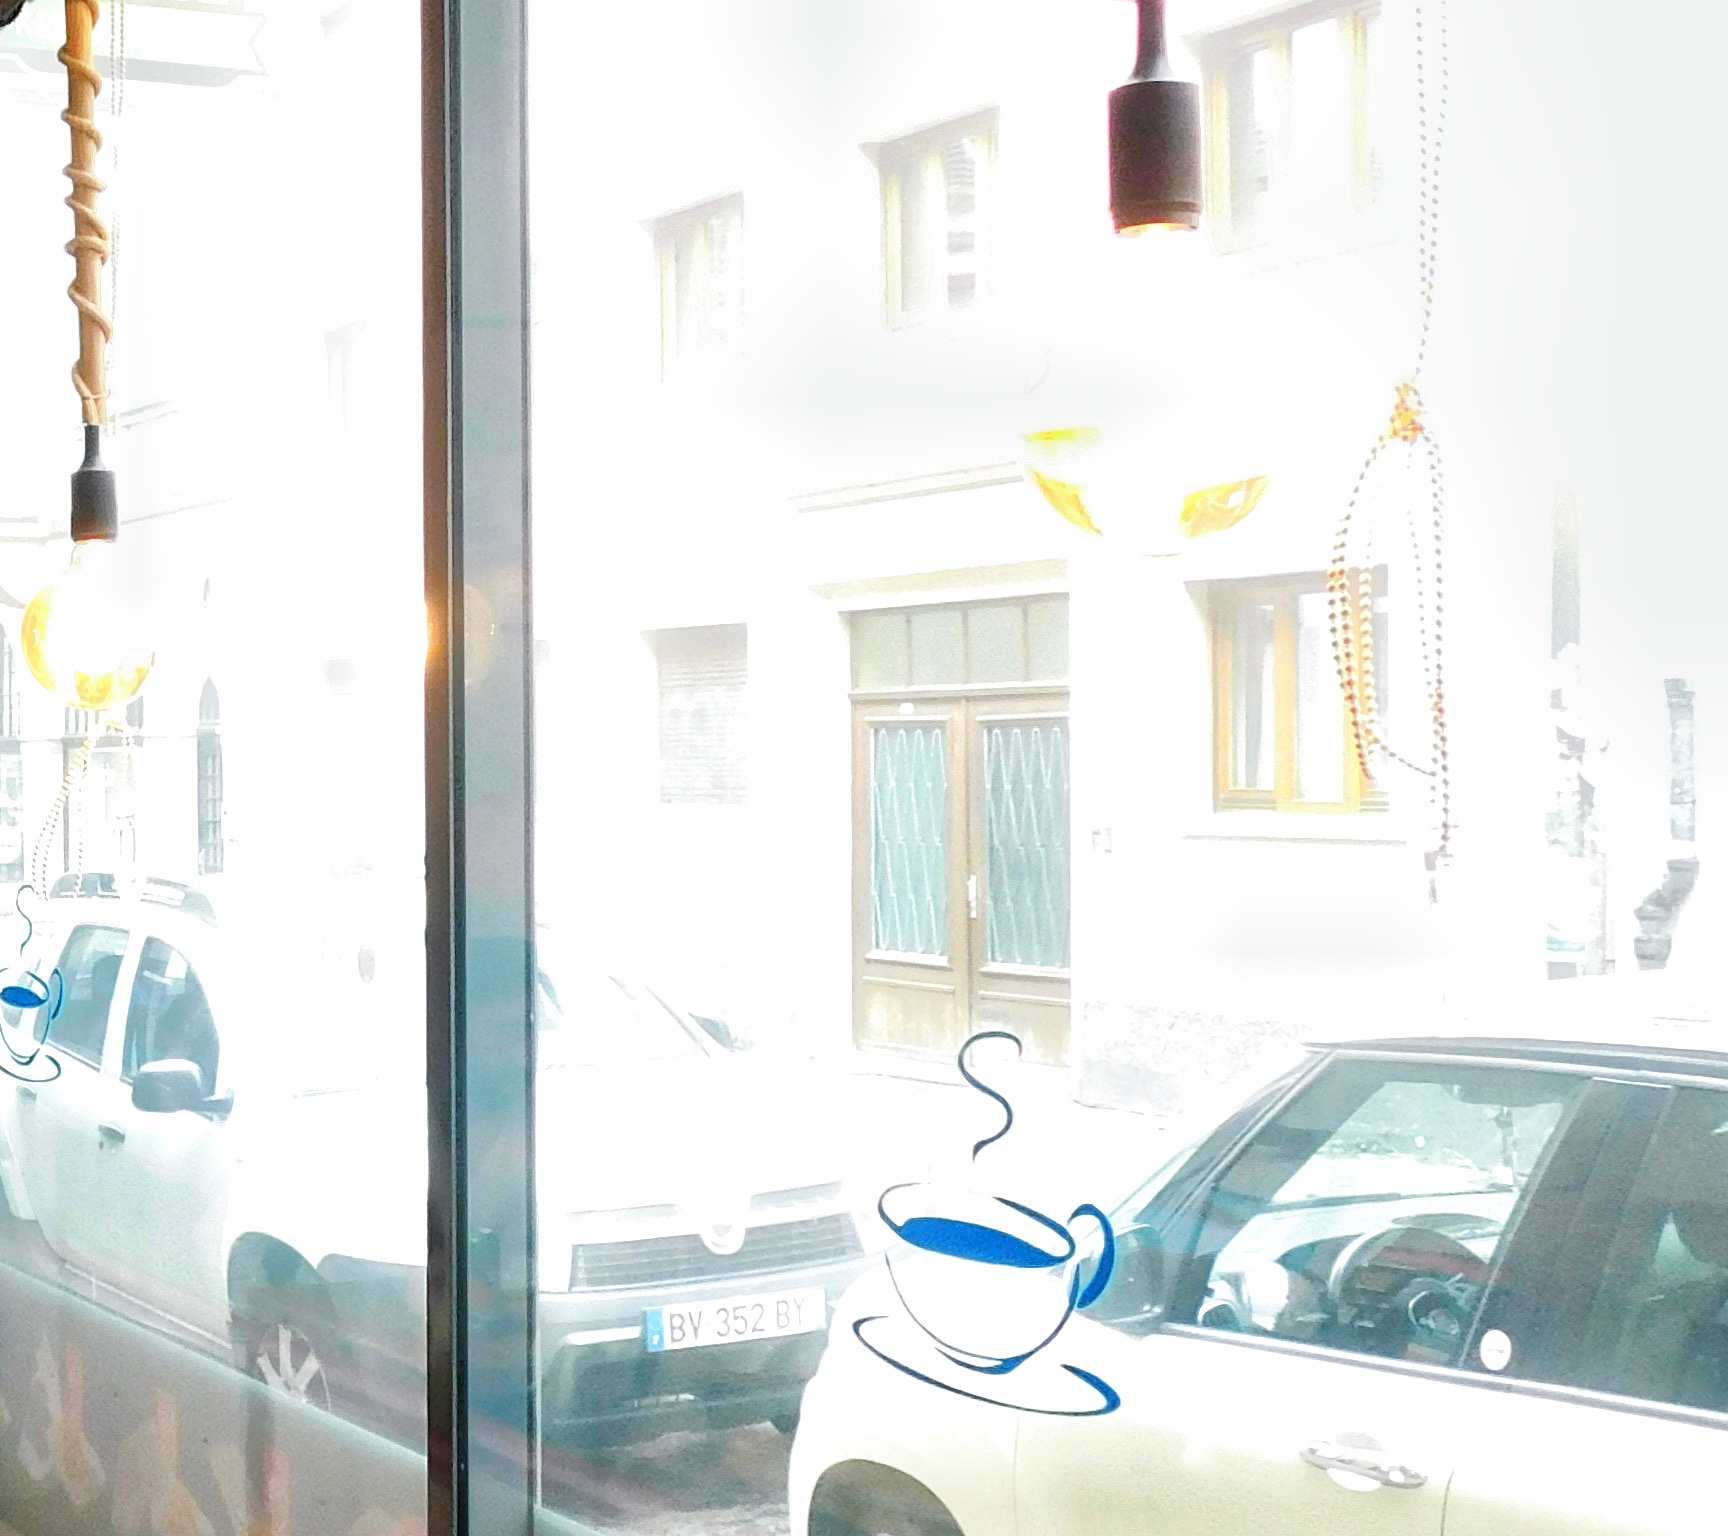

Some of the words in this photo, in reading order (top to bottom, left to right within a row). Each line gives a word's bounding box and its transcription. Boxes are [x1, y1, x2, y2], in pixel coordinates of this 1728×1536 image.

[669, 1310, 702, 1343] BV
[716, 1303, 765, 1337] 352
[776, 1298, 805, 1330] BY
